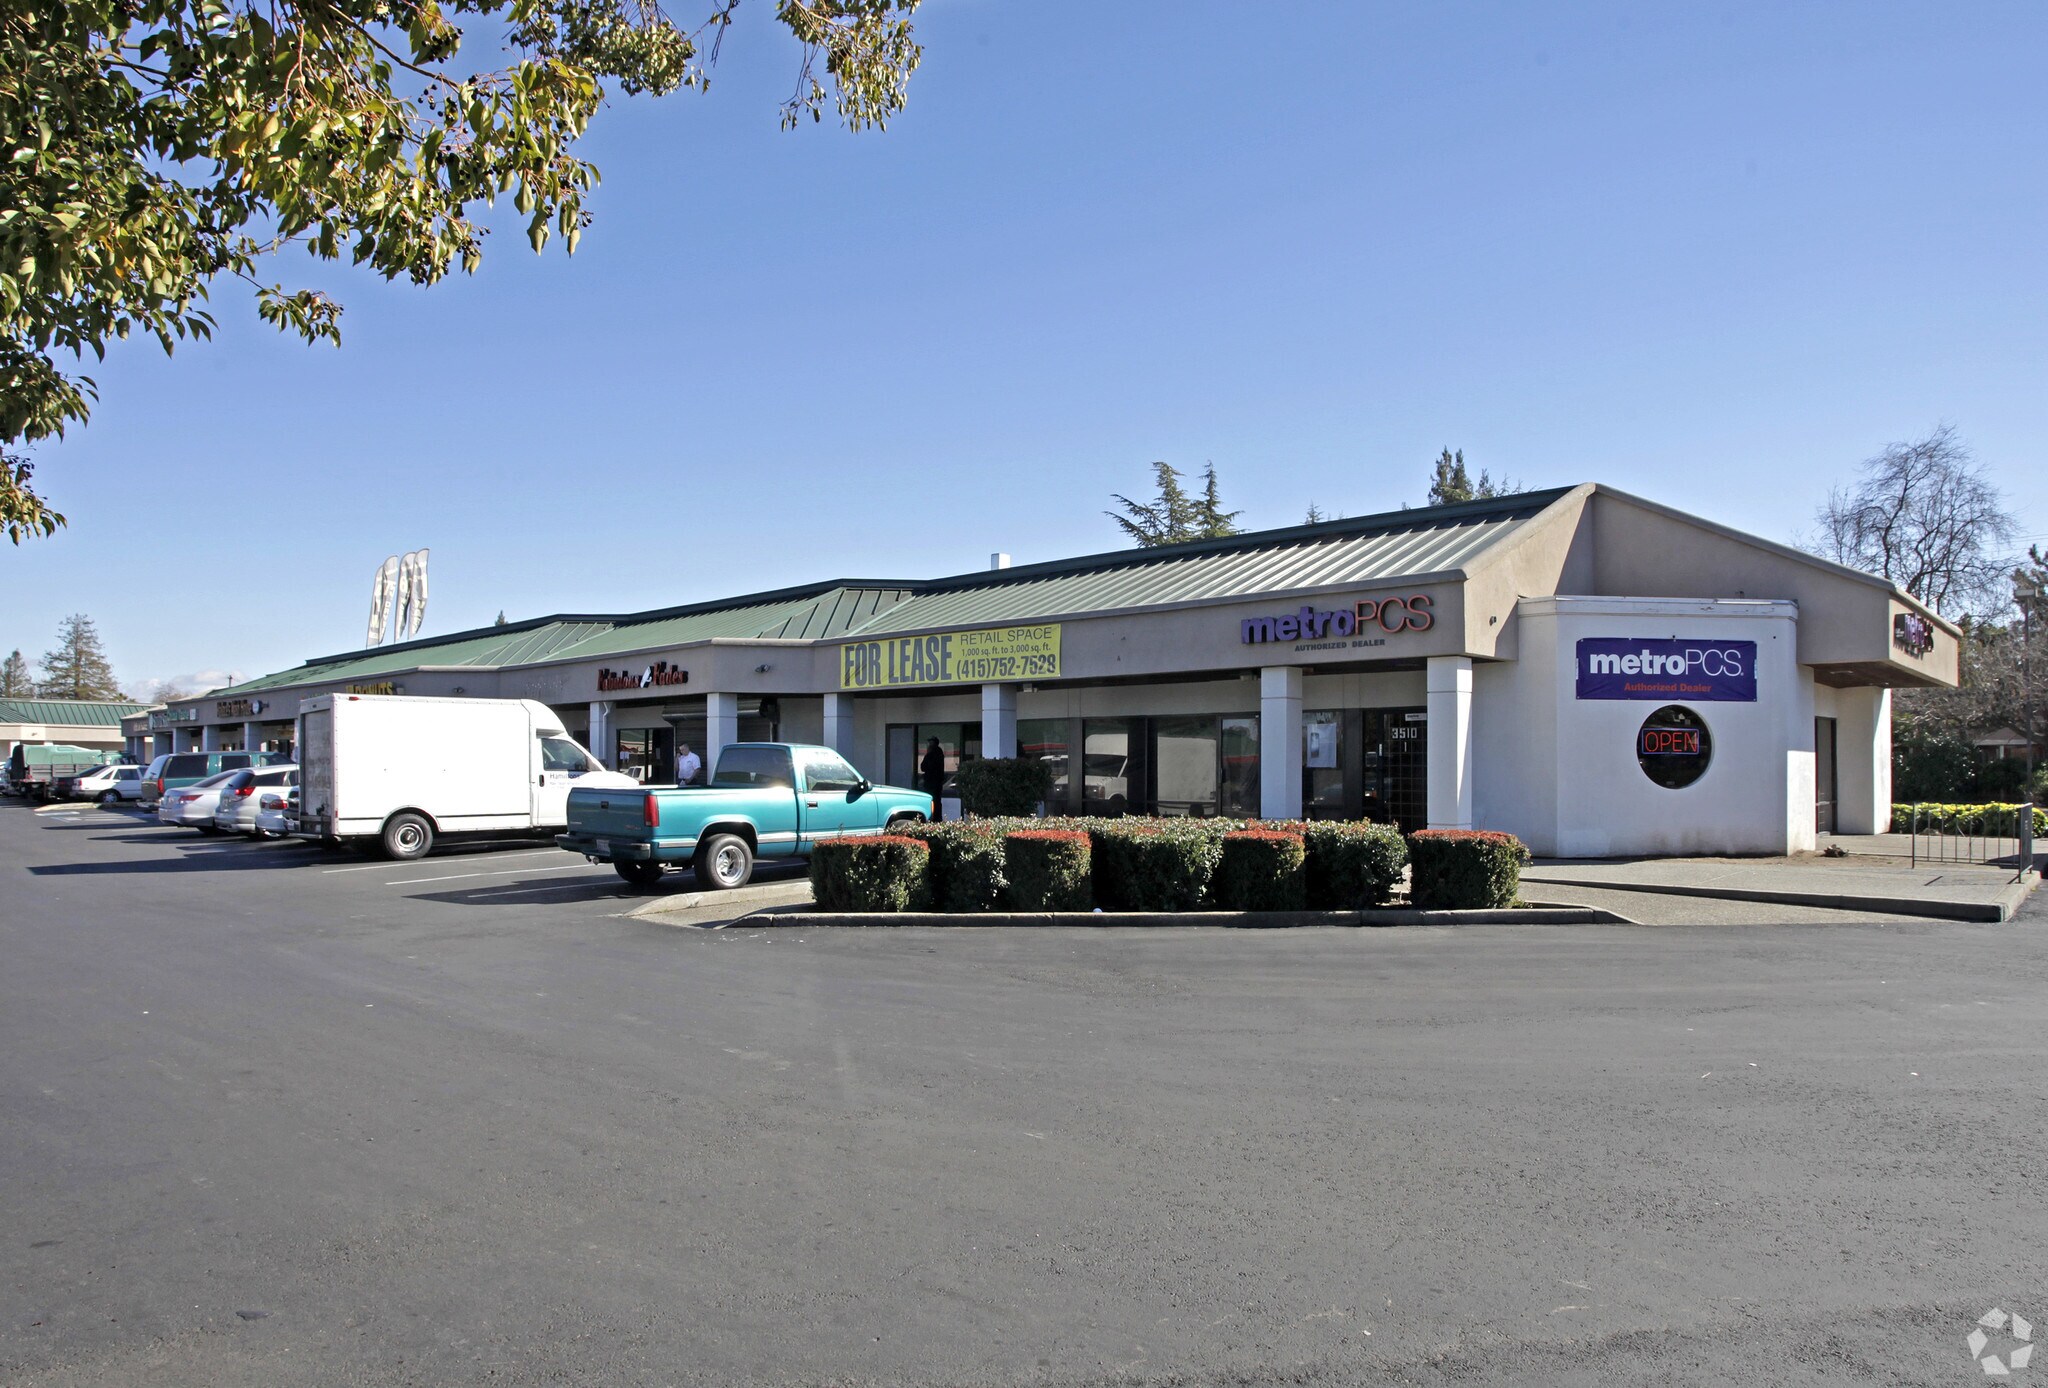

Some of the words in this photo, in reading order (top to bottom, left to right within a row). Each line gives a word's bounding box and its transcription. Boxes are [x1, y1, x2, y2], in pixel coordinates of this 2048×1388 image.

[1241, 594, 1433, 644] metroPCS
[960, 631, 1004, 646] RETAIL
[1007, 627, 1052, 642] SPACE
[1295, 641, 1347, 652] AUTHORIZED
[1352, 639, 1385, 649] DEALER
[962, 647, 980, 657] 1,000
[981, 649, 991, 657] sq.
[992, 646, 1000, 655] ft.
[1001, 645, 1009, 654] to
[1010, 644, 1030, 655] 3,000
[1031, 645, 1041, 654] sq.
[1043, 642, 1051, 651] ft.
[845, 643, 881, 687] FOR
[889, 635, 952, 684] LEASE
[957, 653, 1056, 680] (415)752-7528
[1624, 682, 1677, 692] Authorized
[1680, 683, 1712, 693] Dealer
[1391, 727, 1418, 739] 3510
[1645, 731, 1698, 752] OPEN
